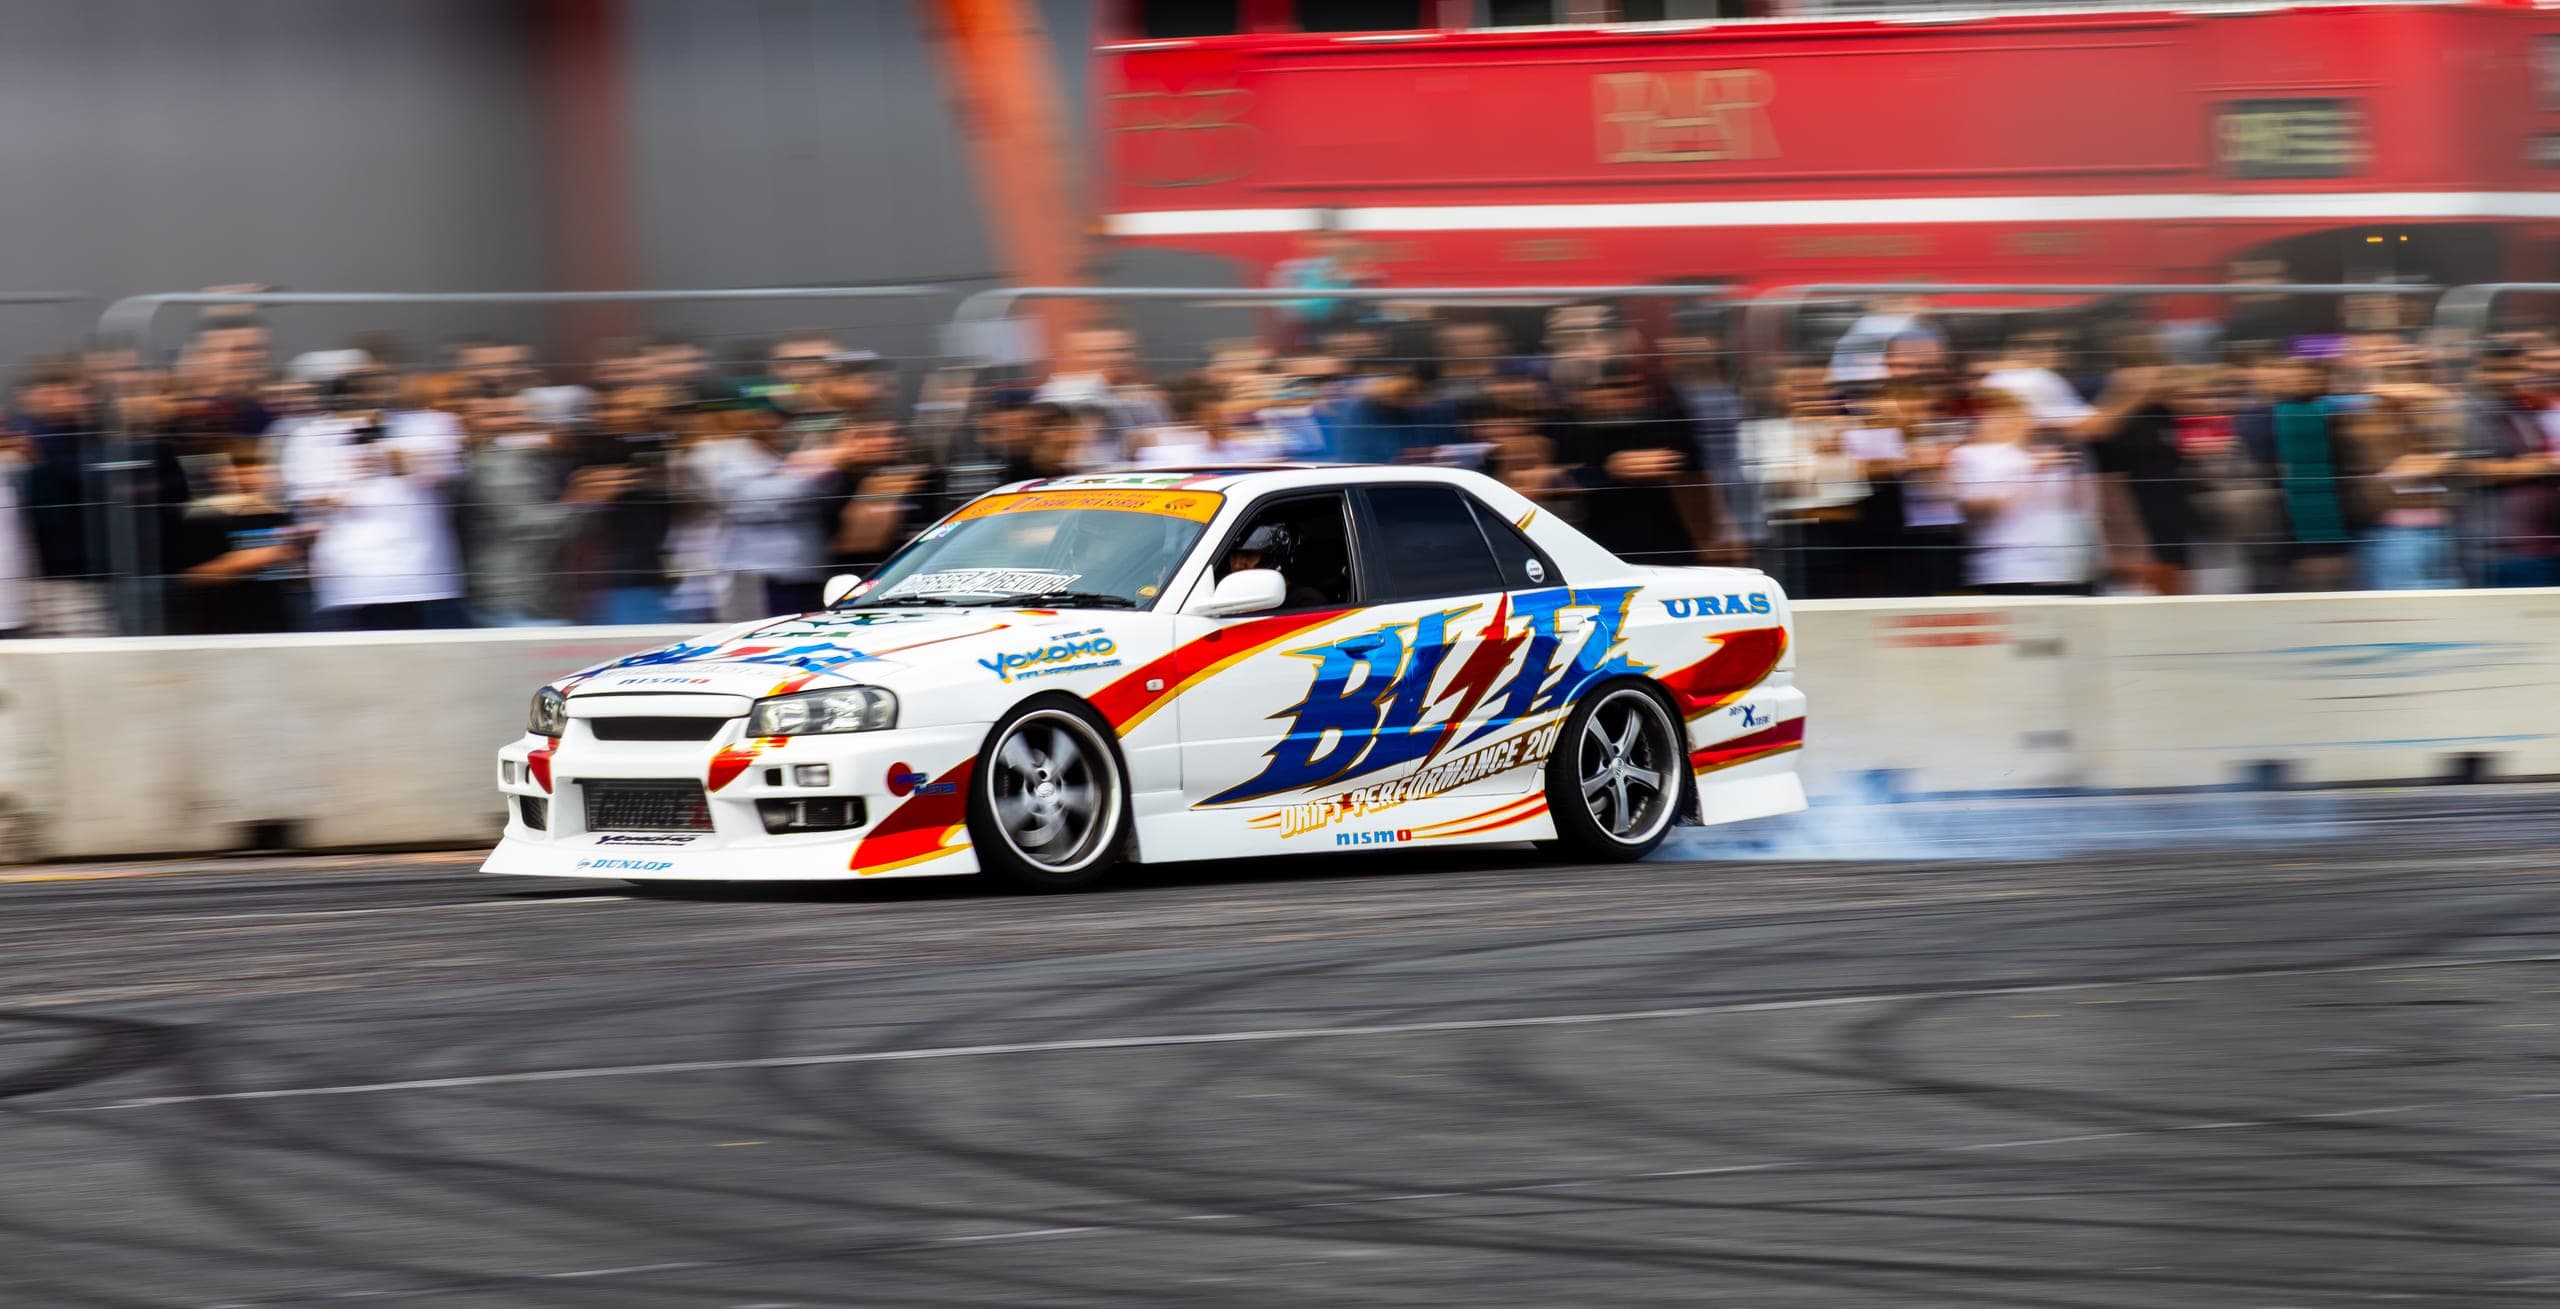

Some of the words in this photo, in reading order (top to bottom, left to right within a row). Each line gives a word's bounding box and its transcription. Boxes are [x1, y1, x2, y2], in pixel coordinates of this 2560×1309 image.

[1658, 592, 1771, 618] URAS
[977, 637, 1117, 684] YOKOMO
[1189, 585, 1658, 808] BLITZ
[1280, 793, 1344, 839] DRIFT
[1350, 736, 1523, 817] PERFORMANCE
[1336, 829, 1412, 846] nismo
[592, 858, 674, 871] DUNLOP
